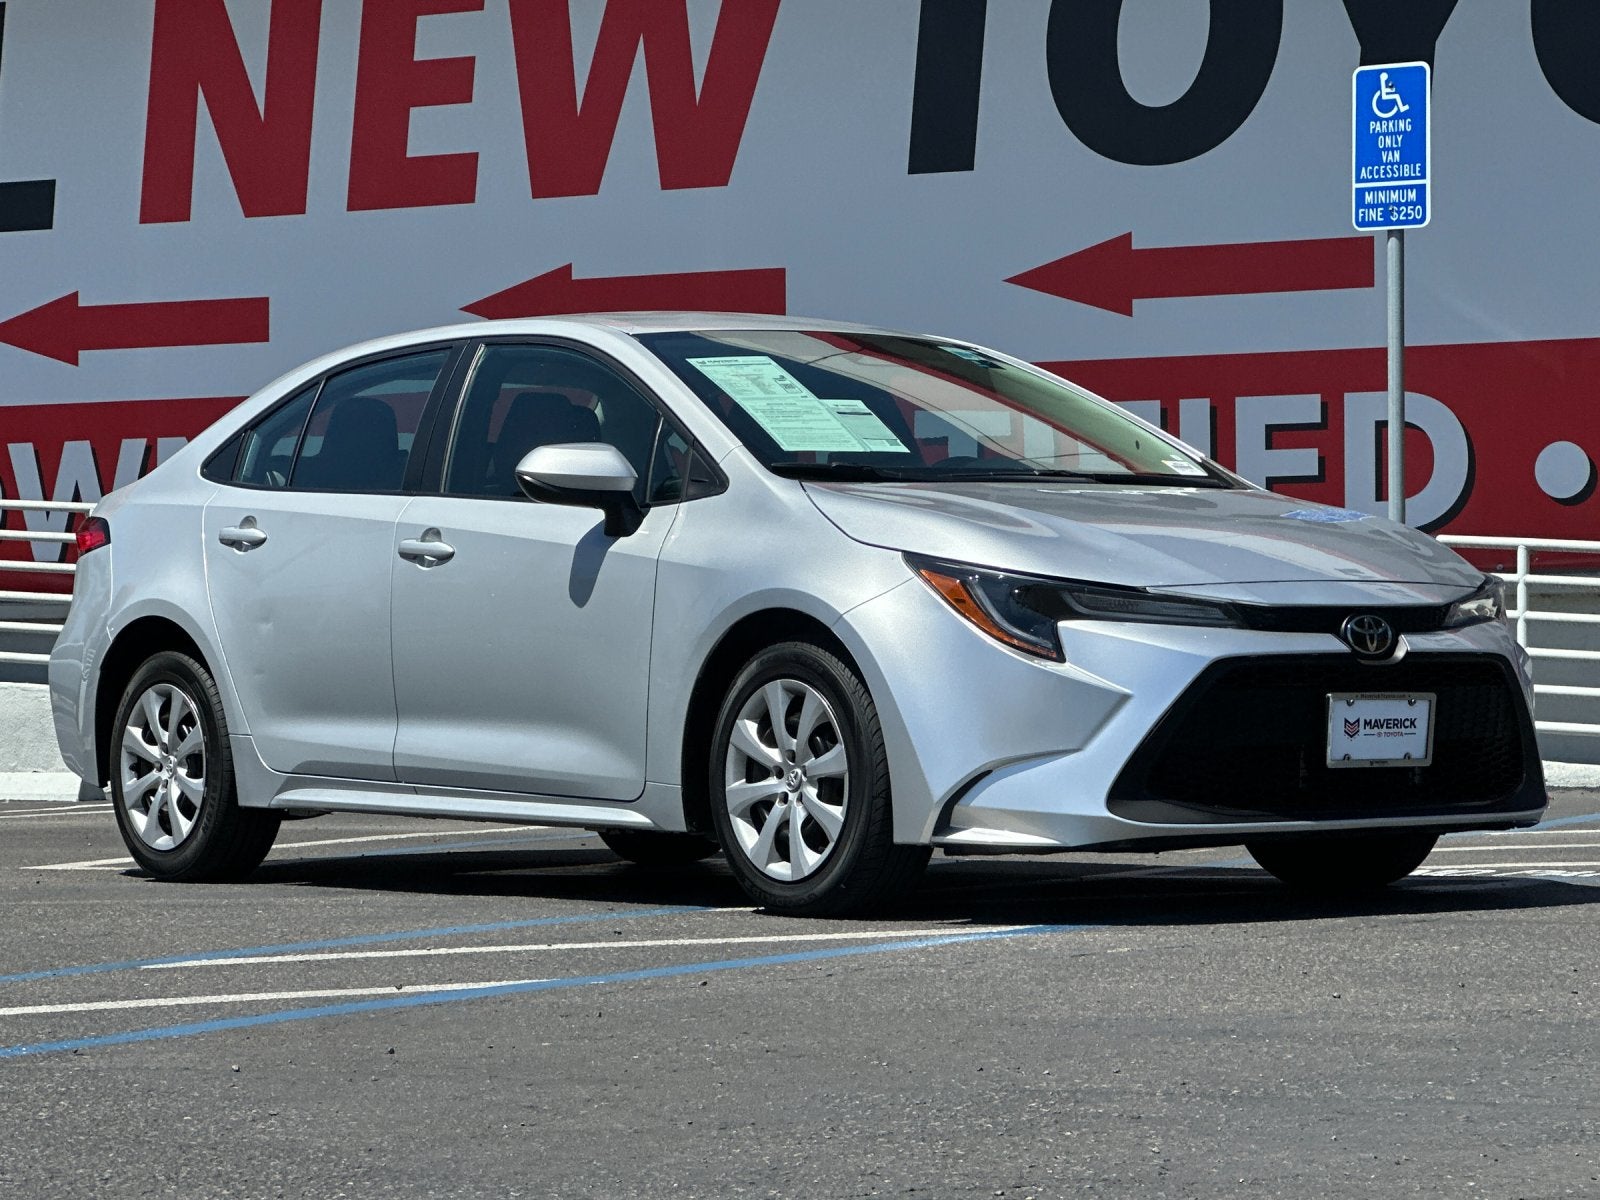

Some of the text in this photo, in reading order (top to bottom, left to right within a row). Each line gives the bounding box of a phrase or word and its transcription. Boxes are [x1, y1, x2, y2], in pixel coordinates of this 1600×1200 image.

[139, 0, 782, 224] NEW
[1369, 118, 1411, 133] PARKING
[1377, 134, 1402, 148] ONLY
[1381, 149, 1400, 162] VAN
[1360, 163, 1421, 178] ACCESSIBLE
[1364, 188, 1416, 204] MINIMUM
[1358, 205, 1422, 221] FINE $250
[1363, 717, 1417, 729] MAVERICK
